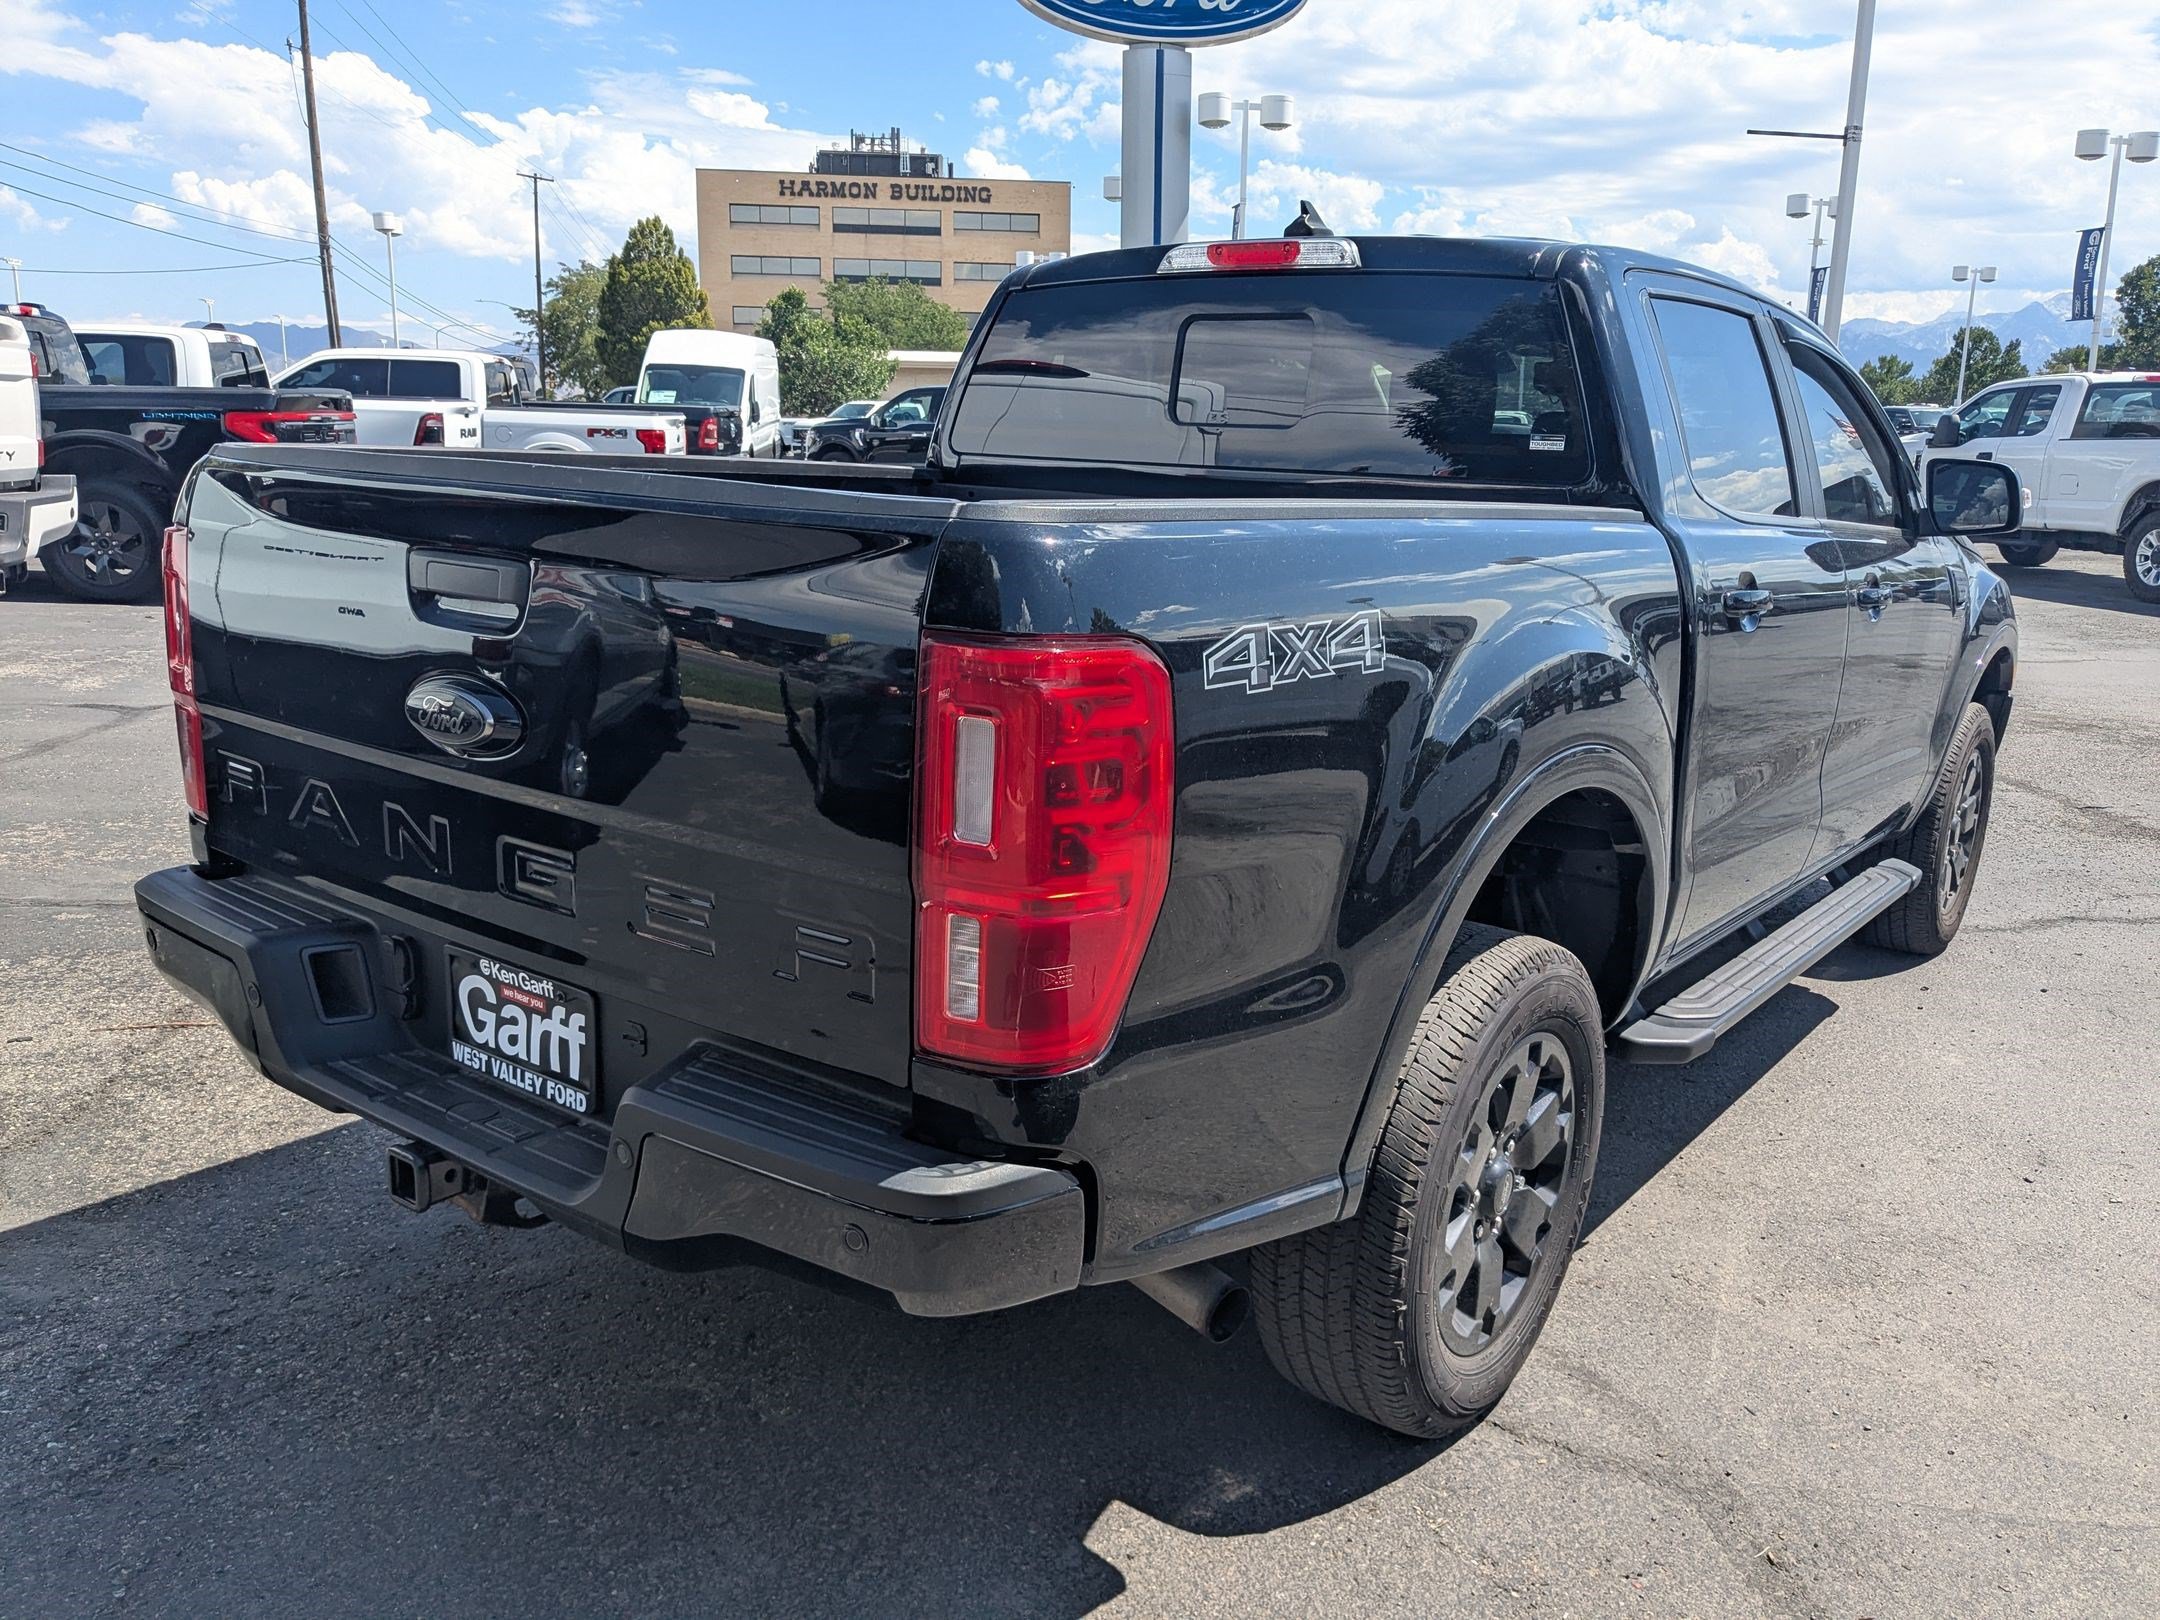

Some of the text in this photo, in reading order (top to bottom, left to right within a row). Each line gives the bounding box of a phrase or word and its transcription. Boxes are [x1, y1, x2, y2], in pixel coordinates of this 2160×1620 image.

[779, 179, 992, 204] HARMON BUILDING
[2084, 247, 2092, 270] Ford
[418, 696, 465, 734] Ford
[216, 748, 876, 1004] RANGER
[490, 960, 518, 987] Ken
[519, 972, 554, 999] Garff
[504, 988, 543, 1009] we hear you
[458, 974, 586, 1081] Garff
[452, 1041, 587, 1113] WEST VALLEY FORD
